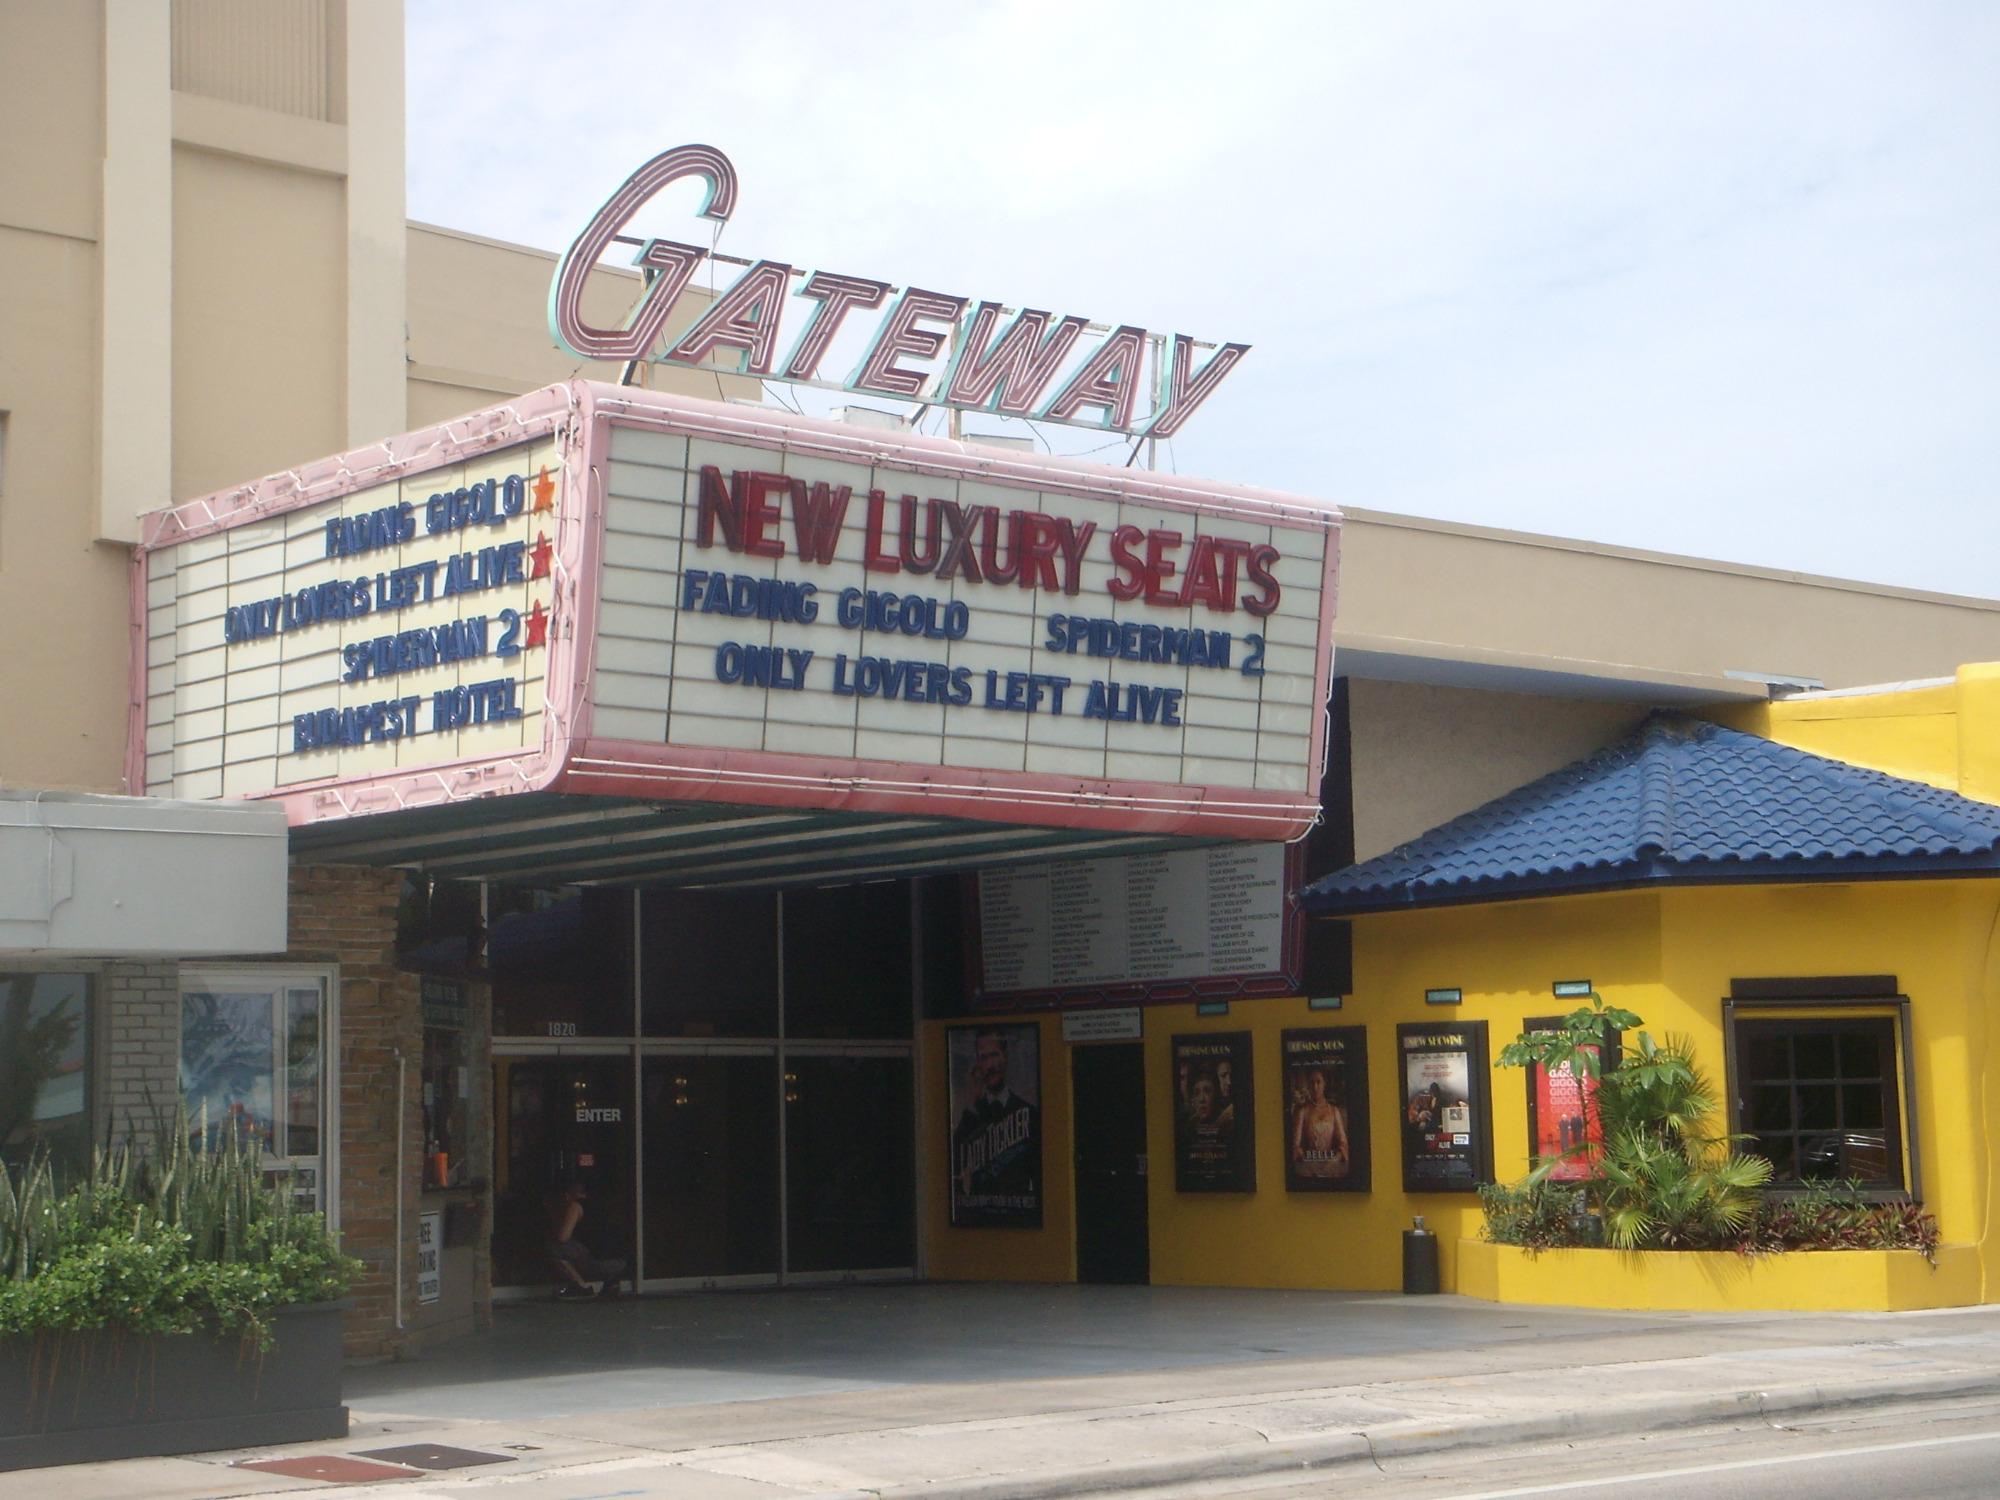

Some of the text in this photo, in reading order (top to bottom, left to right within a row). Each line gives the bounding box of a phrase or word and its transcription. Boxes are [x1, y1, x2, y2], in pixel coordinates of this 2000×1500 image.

[551, 144, 1252, 439] GATEWAY
[326, 474, 524, 558] FADING GIGOLO
[695, 465, 1281, 617] NEW LUXURY SEATS
[225, 540, 525, 645] ONLY LOVERS LEFT ALIVE
[683, 568, 970, 641] FADING GIGOLO
[343, 608, 521, 683] SPIDERMAN 2
[1045, 613, 1266, 678] SPIDERMAN 2
[294, 677, 522, 752] BUDAPEST HOTEL
[714, 640, 1184, 727] ONLY LOVERS LEFT ALIVE
[548, 1021, 576, 1037] 1820
[576, 1108, 621, 1122] ENTER
